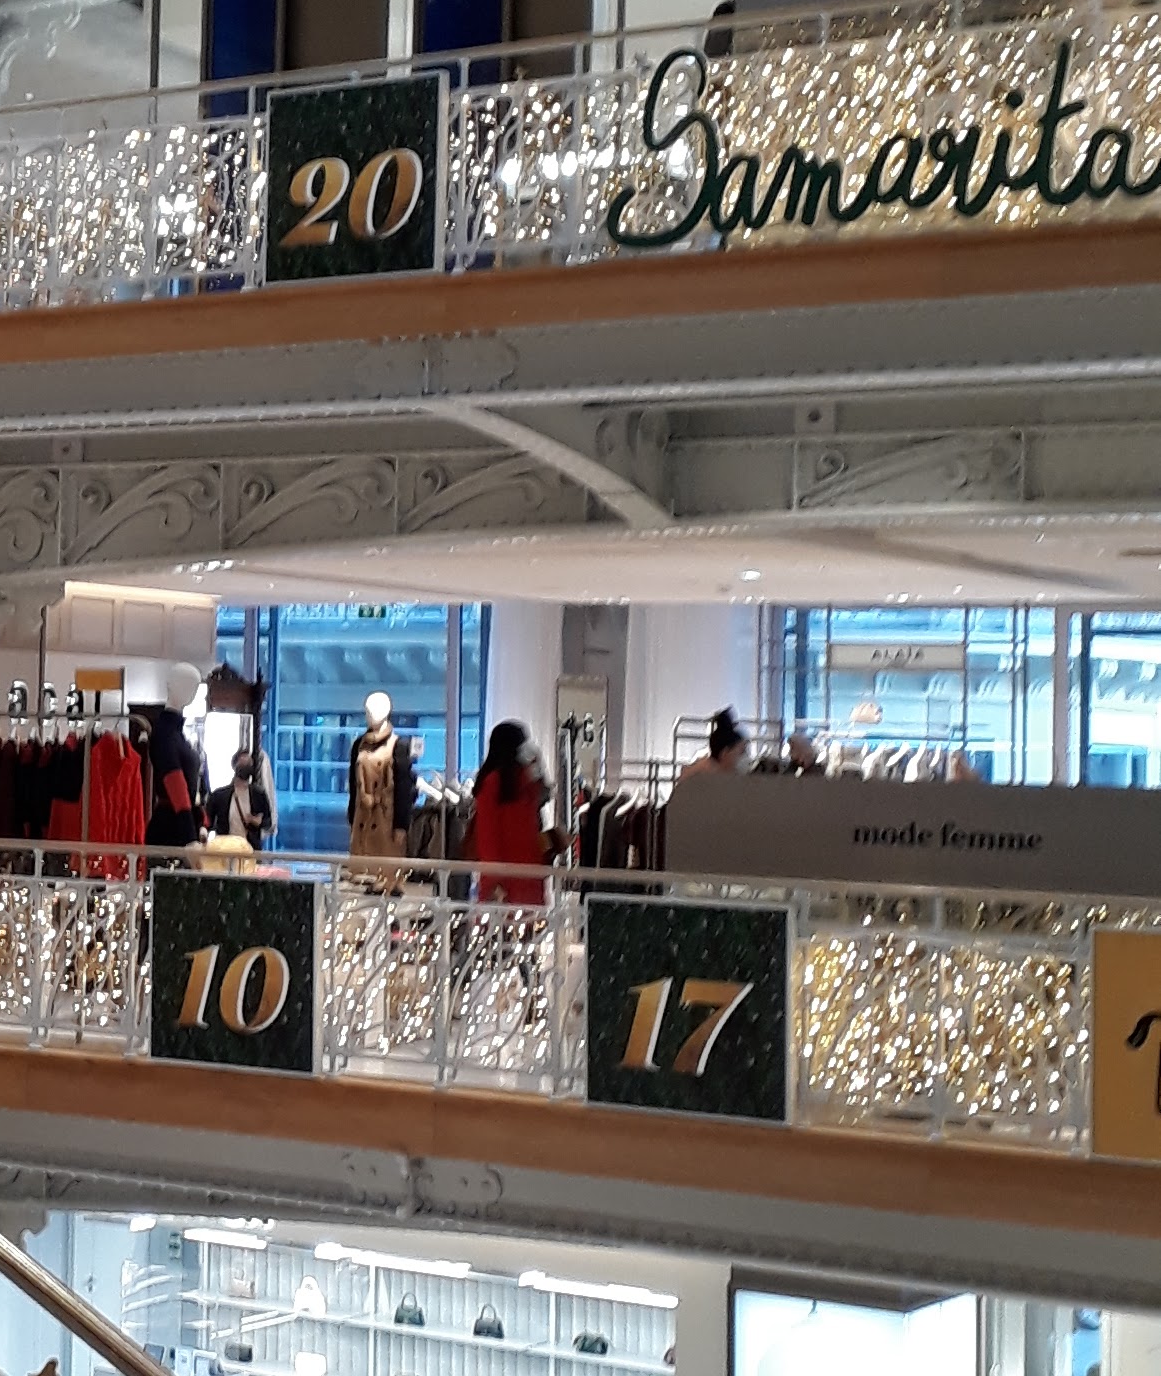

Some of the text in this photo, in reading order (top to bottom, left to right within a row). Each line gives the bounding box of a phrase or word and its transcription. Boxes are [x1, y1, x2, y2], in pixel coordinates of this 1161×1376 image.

[280, 148, 423, 246] 20
[853, 819, 1043, 851] mode femme
[177, 944, 290, 1035] 10
[620, 976, 755, 1077] 17
